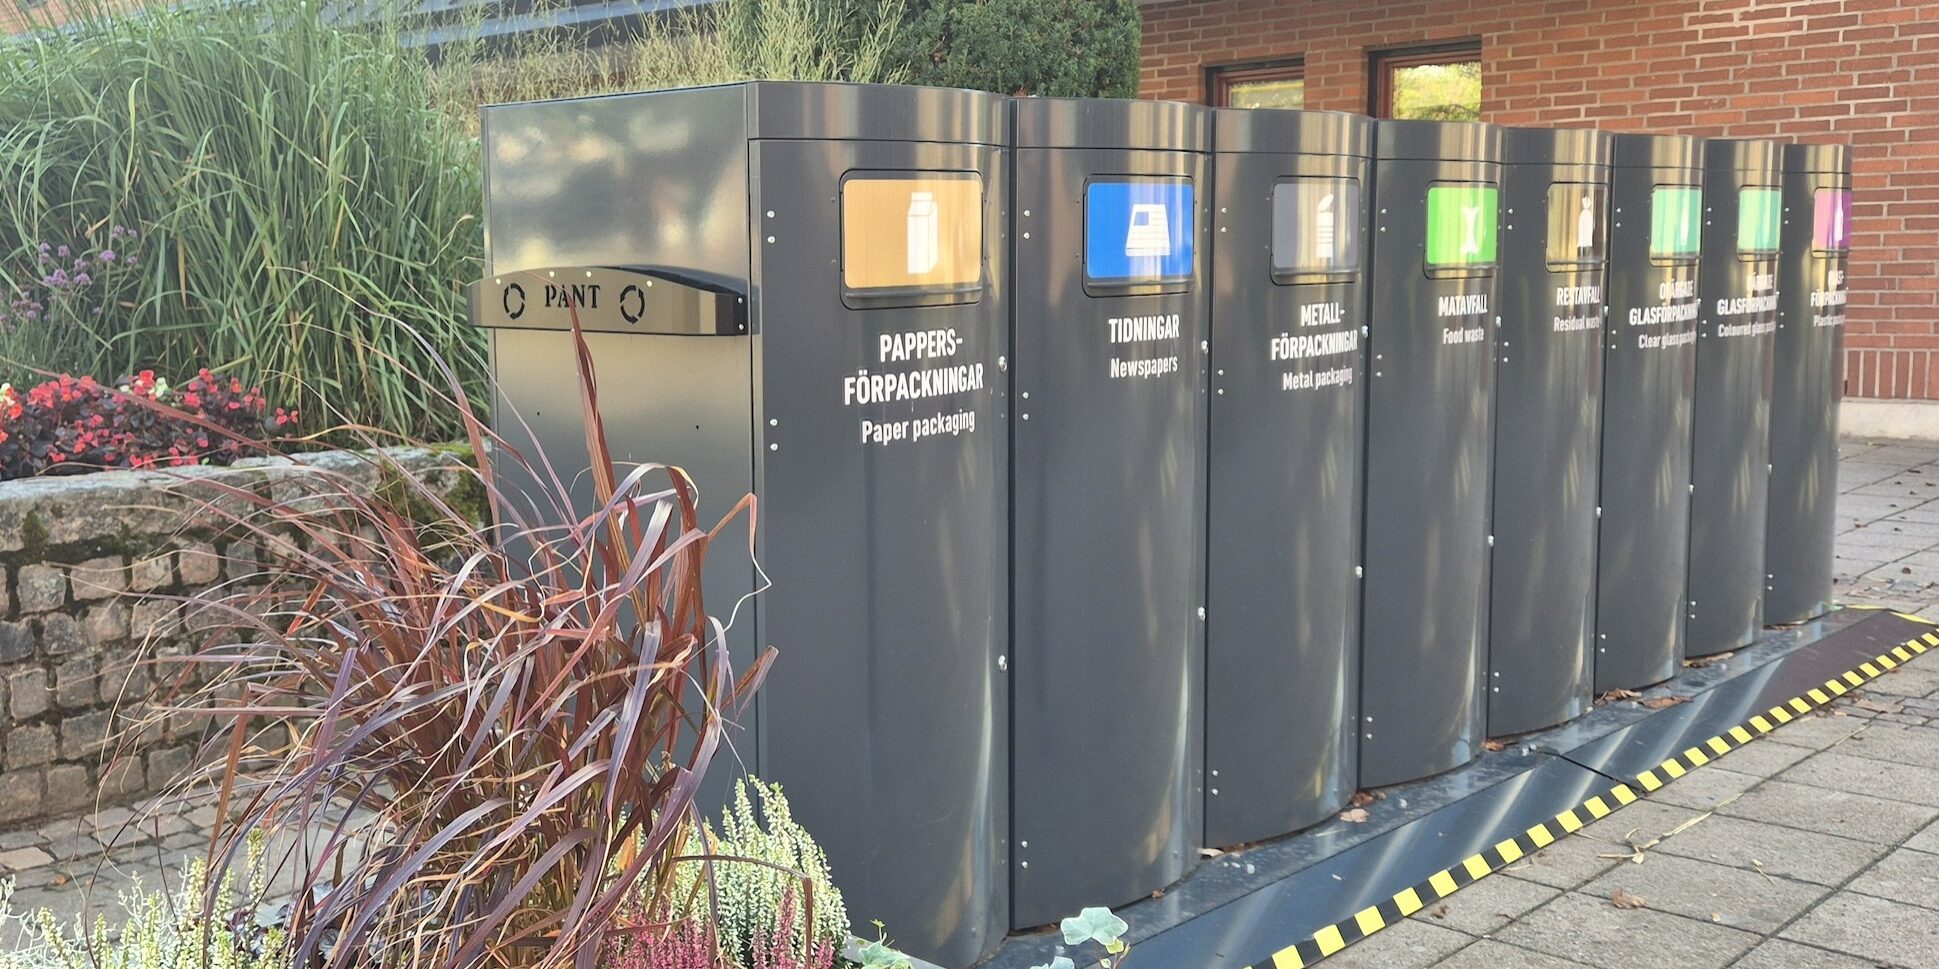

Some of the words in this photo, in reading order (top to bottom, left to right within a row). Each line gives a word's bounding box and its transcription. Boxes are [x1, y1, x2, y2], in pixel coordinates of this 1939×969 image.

[545, 284, 600, 308] PANT
[1438, 294, 1488, 316] MATAVFALL
[1556, 286, 1600, 306] RESTAVFALL
[1301, 302, 1345, 327] METALL-
[1553, 315, 1585, 332] Residual
[1108, 314, 1179, 343] TIDNINGAR
[1443, 327, 1463, 344] Food
[880, 328, 963, 363] PAPPERS-
[1271, 329, 1358, 361] FÖRPACKNINGAR
[1639, 334, 1661, 348] Clear
[1110, 356, 1178, 379] Newspapers
[1283, 370, 1313, 391] Metal
[1315, 365, 1352, 390] packaging
[844, 363, 984, 406] FÖRPACKNINGAR
[862, 420, 909, 446] Paper
[913, 408, 975, 442] packaging
